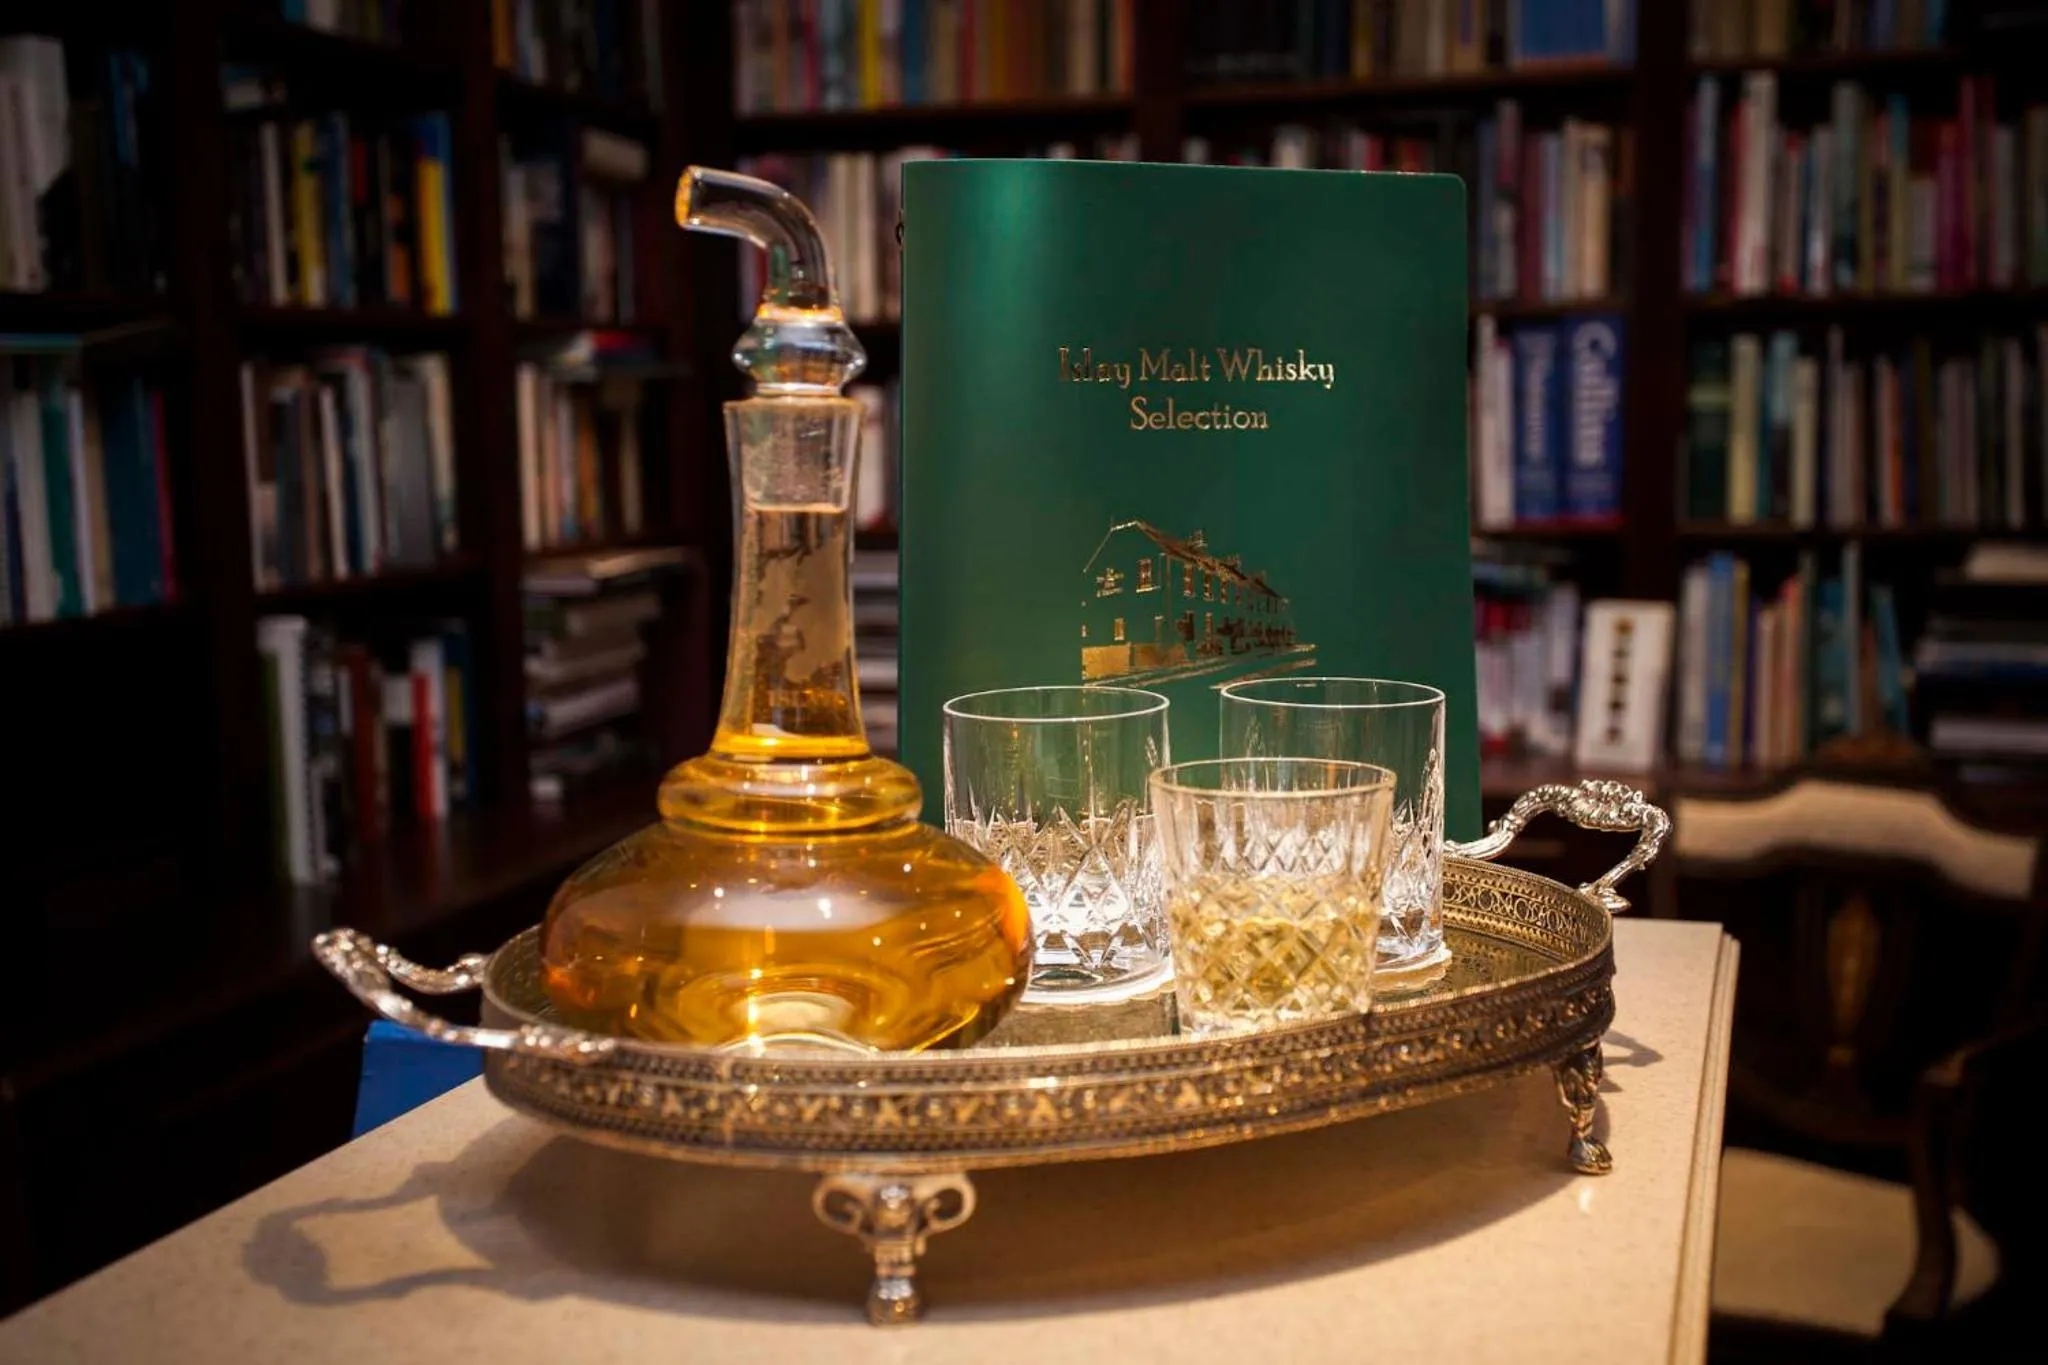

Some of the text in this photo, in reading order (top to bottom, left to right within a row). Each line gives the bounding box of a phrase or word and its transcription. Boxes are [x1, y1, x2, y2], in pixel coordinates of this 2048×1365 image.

[1058, 346, 1336, 390] Islay Malt Whisky
[1129, 395, 1269, 431] Selection
